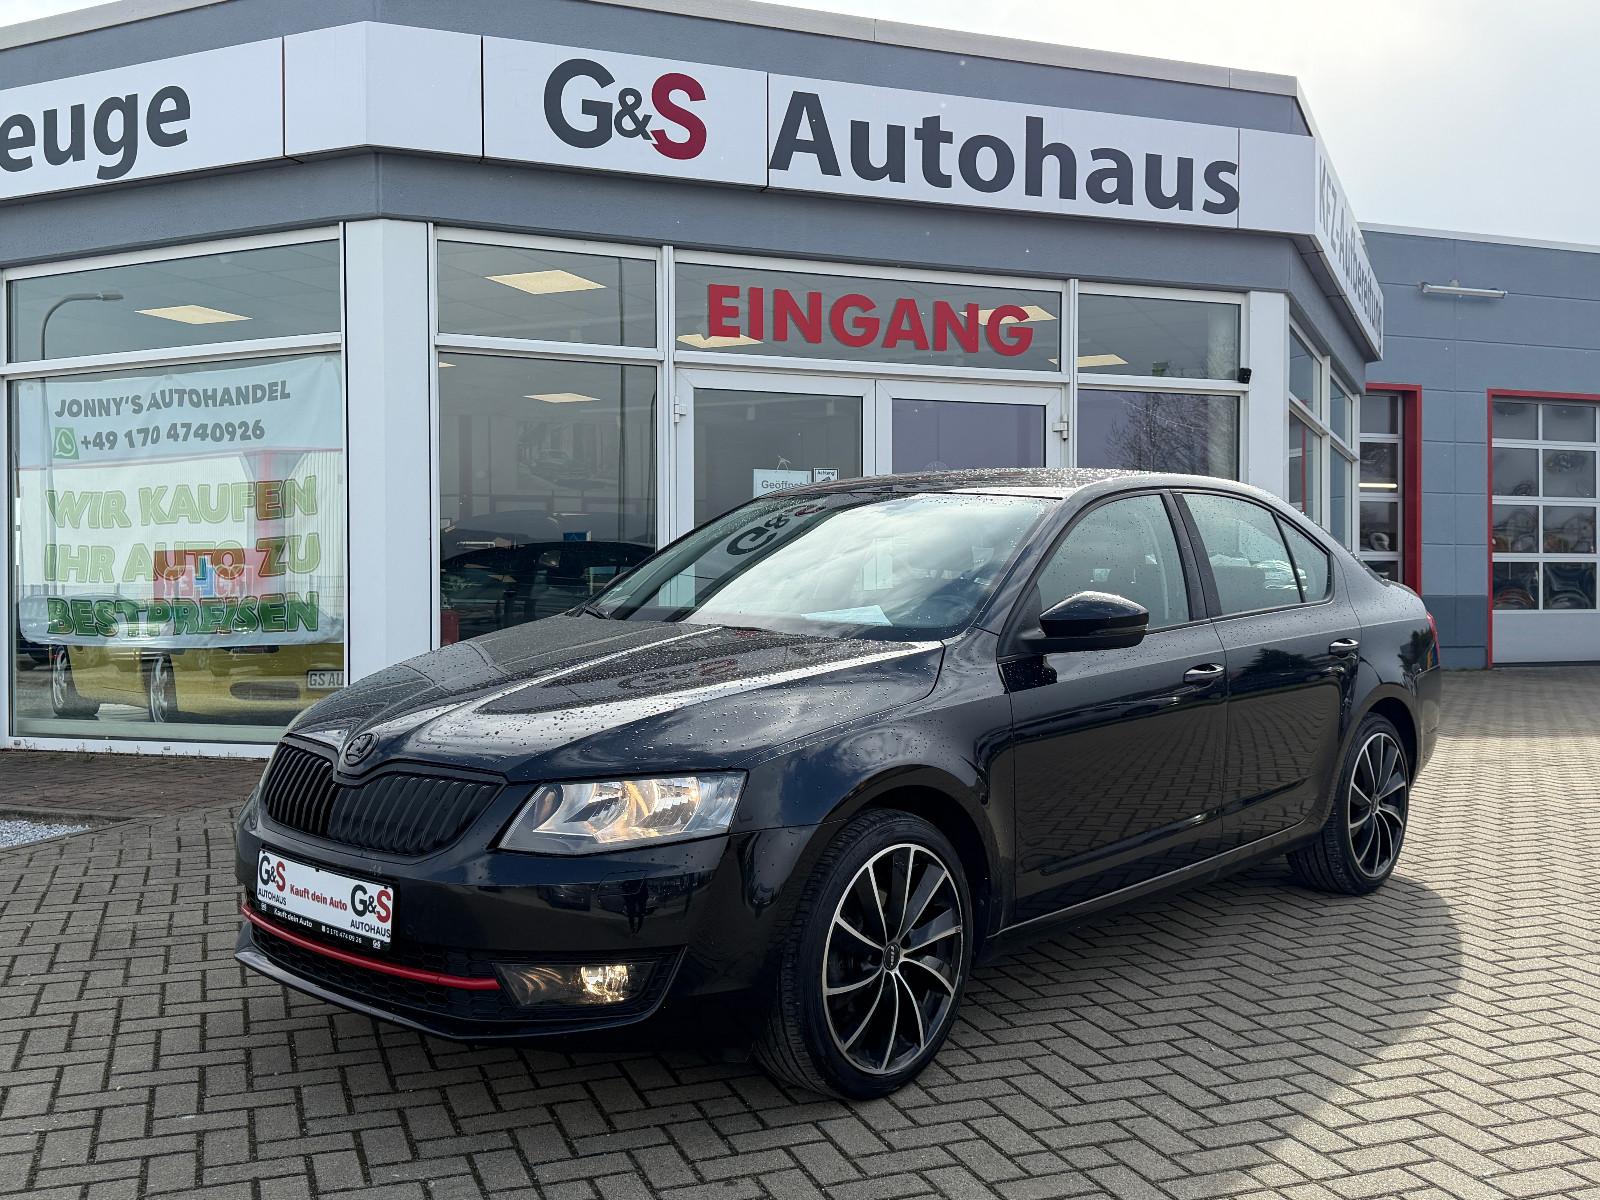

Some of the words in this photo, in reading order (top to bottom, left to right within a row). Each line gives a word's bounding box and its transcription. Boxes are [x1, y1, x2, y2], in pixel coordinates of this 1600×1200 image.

[0, 85, 191, 180] euge
[543, 58, 707, 160] G&S
[769, 90, 1240, 216] Autohaus
[707, 283, 1034, 356] EINGANG
[146, 380, 291, 411] AUTOHANDEL
[81, 431, 118, 450] +49
[124, 426, 161, 449] 170
[166, 419, 266, 443] 4740926
[46, 489, 132, 529] WIR
[138, 475, 318, 525] KAUFEN
[44, 543, 116, 583] IHR
[122, 539, 246, 582] AUTO
[256, 532, 321, 578] ZU
[258, 855, 286, 892] G&S
[258, 888, 287, 906] AUTOHAUS
[290, 884, 310, 902] Kauft
[311, 892, 328, 905] dein
[328, 896, 348, 912] Auto
[350, 884, 392, 924] G&S
[350, 919, 391, 938] AUTOHAUS
